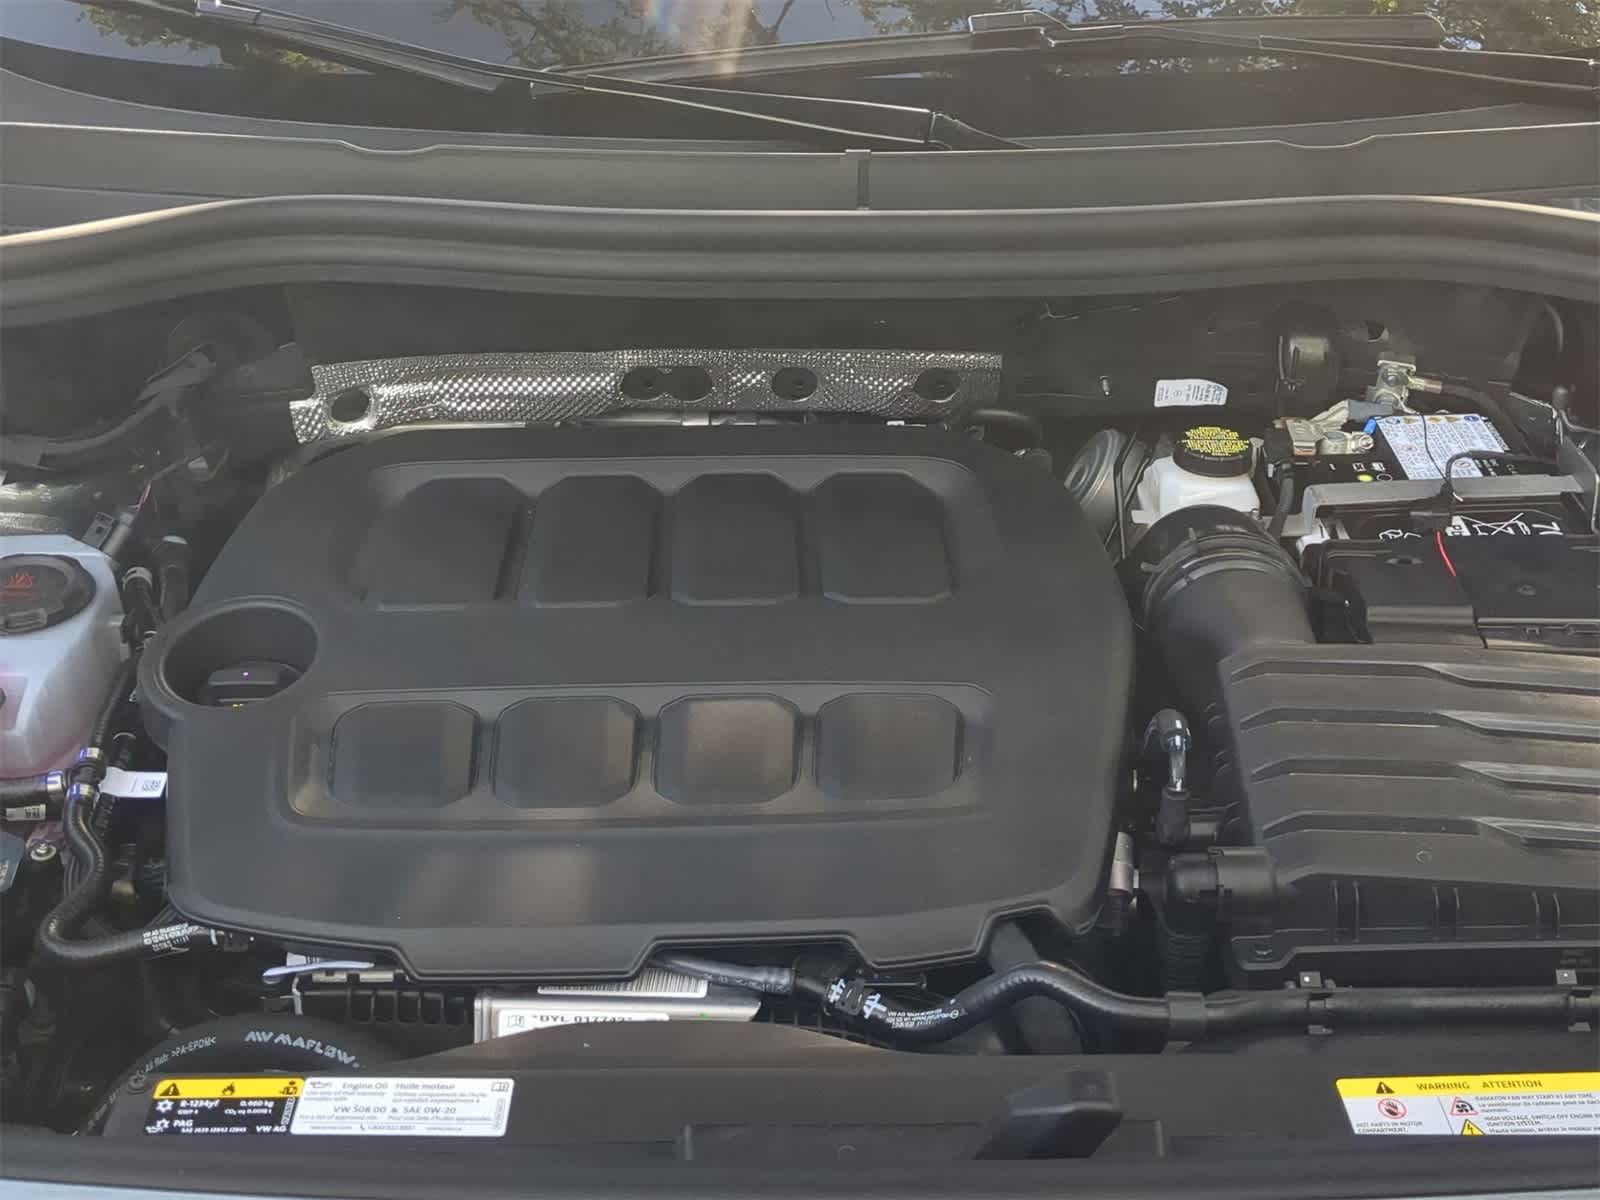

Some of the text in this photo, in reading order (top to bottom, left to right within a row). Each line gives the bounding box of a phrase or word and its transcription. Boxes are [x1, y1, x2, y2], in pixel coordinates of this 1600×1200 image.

[342, 1082, 373, 1090] Engine
[1416, 1080, 1543, 1090] WARNING ATTENTION
[179, 1099, 220, 1109] R-1234yf
[173, 1119, 194, 1127] PAG
